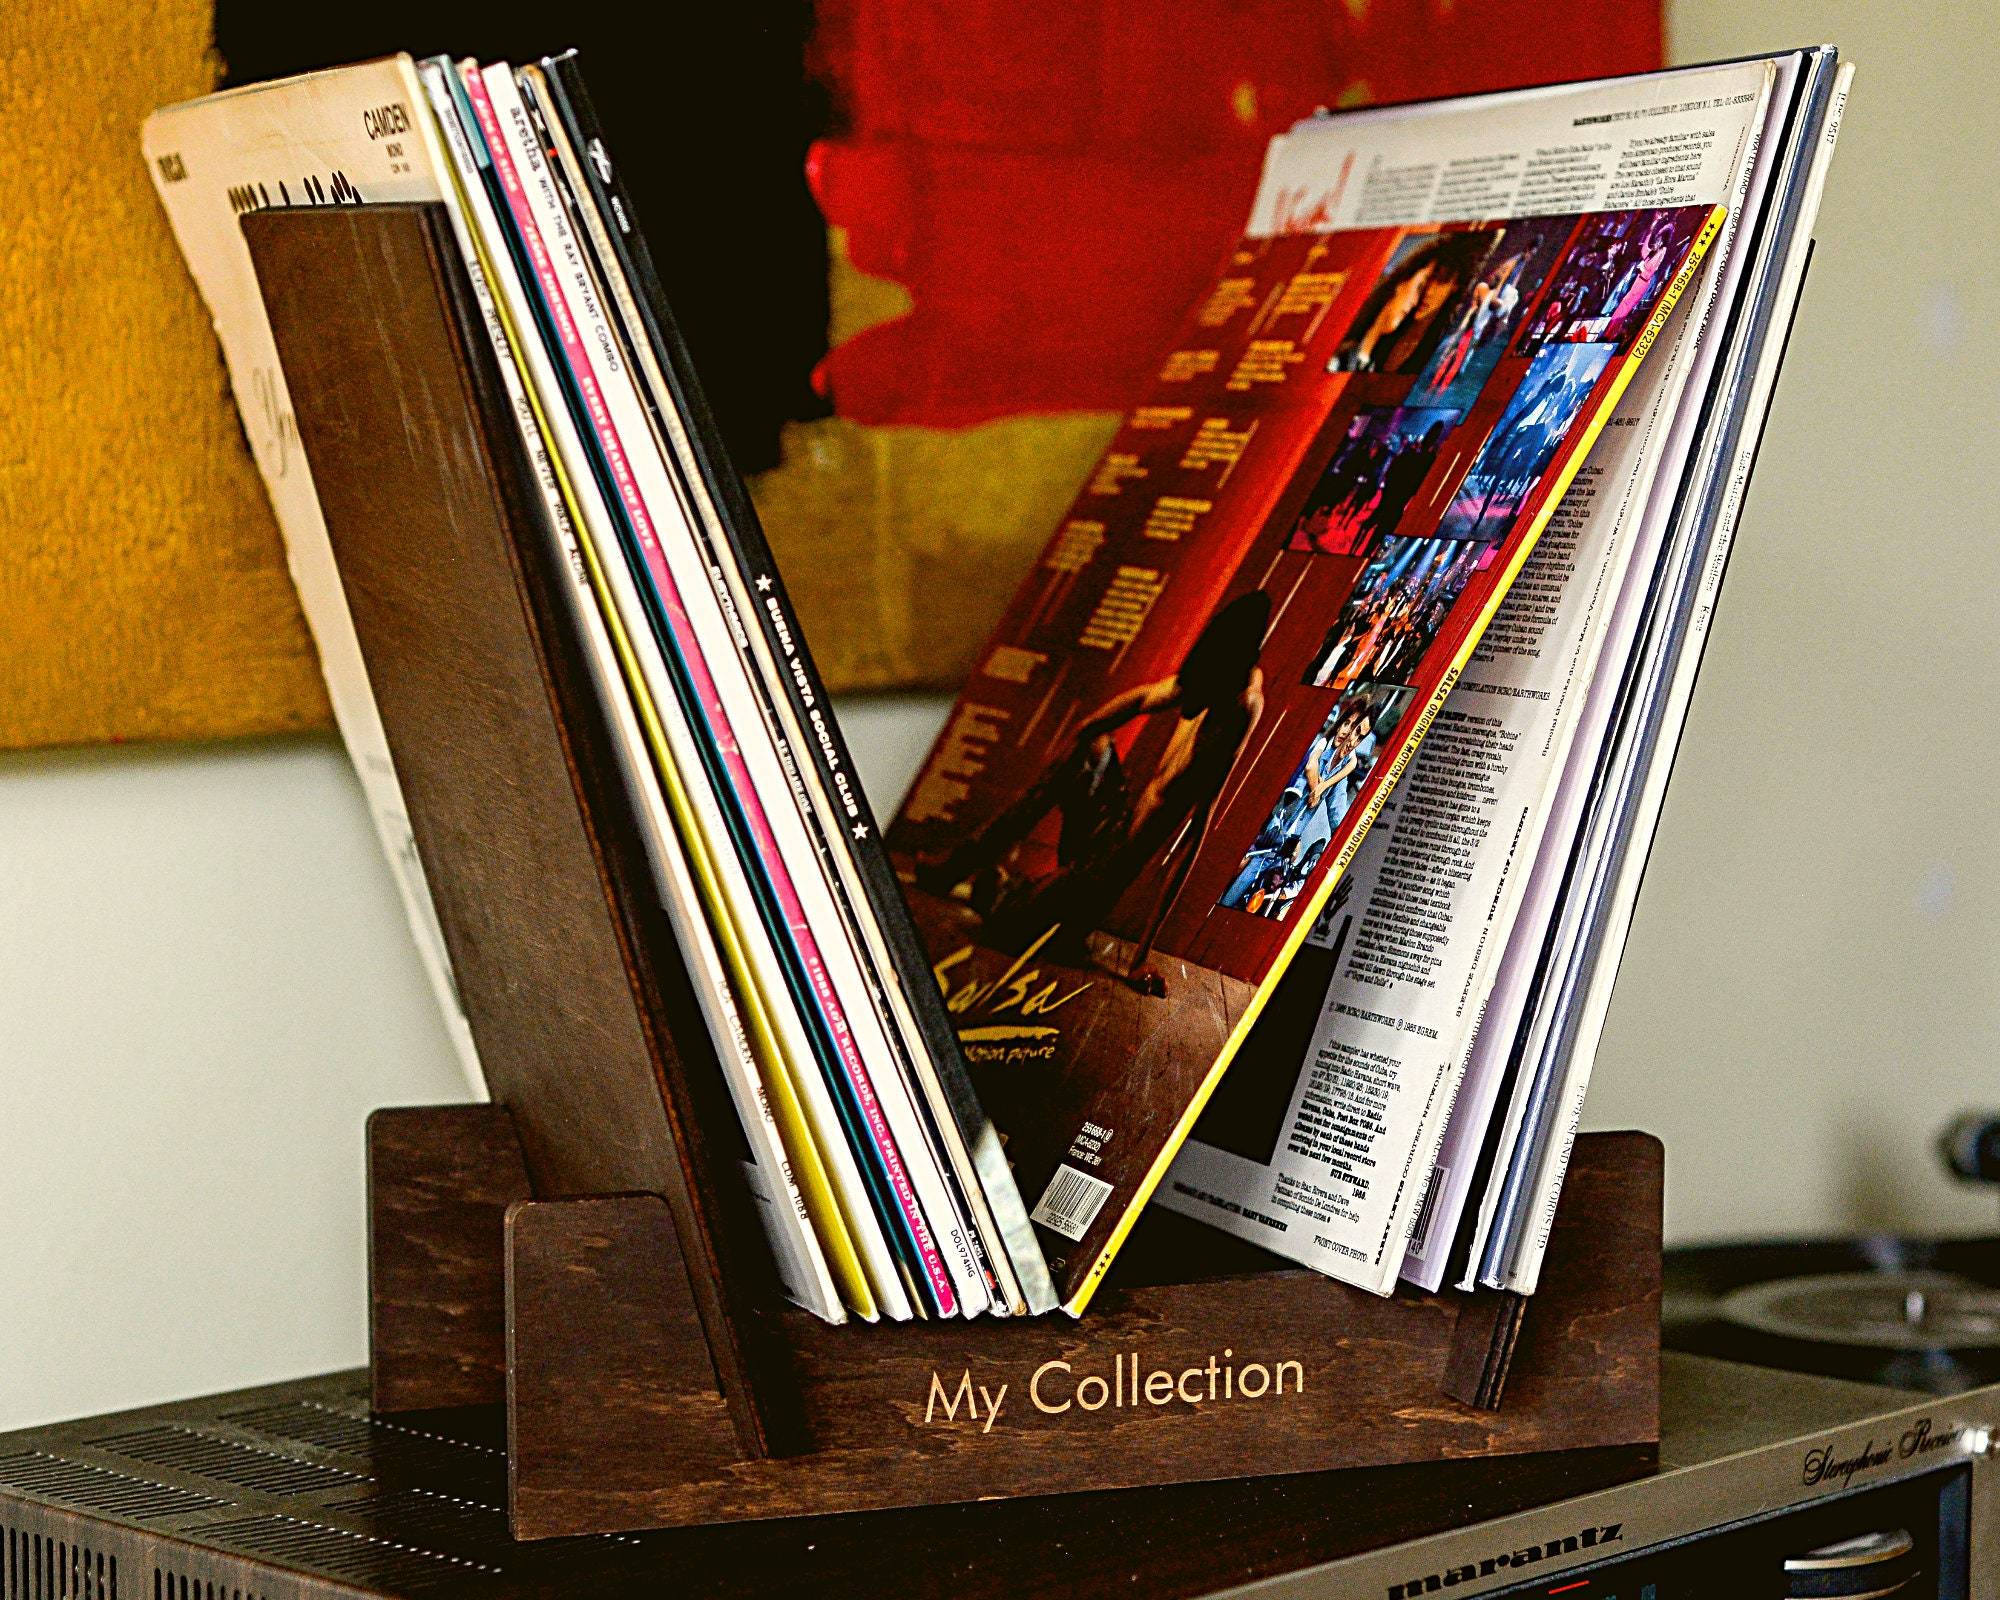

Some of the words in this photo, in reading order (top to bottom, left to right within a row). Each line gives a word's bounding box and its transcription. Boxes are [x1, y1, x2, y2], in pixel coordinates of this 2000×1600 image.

[363, 103, 411, 140] CAMDEN
[1825, 120, 1838, 144] 9517
[1738, 167, 1751, 195] RITMO
[1747, 155, 1755, 165] EL
[509, 104, 545, 172] aretha
[537, 175, 557, 210] WITH
[551, 214, 567, 237] THE
[563, 242, 578, 266] RAY
[572, 270, 599, 320] BRYANT
[594, 323, 619, 372] COMBO
[1729, 205, 1741, 228] CUBA
[1713, 259, 1726, 291] CUBAN
[1630, 298, 1673, 360] (MCA-6232)
[1702, 292, 1717, 322] DANCE
[1693, 323, 1706, 350] MUSIC
[540, 270, 576, 344] JOHNSON
[581, 375, 607, 426] EVERY
[601, 428, 629, 482] SHADE
[622, 483, 637, 505] OF
[632, 508, 654, 549] LOVE
[1555, 677, 1571, 715] thanks
[1567, 656, 1578, 676] due
[1574, 644, 1581, 655] to
[1578, 614, 1591, 642] Mary
[1605, 537, 1615, 556] Ian
[1624, 478, 1634, 497] and
[1433, 666, 1460, 702] SALSA
[1511, 686, 1551, 701] EARTHWORKS
[764, 596, 796, 656] BUENA
[788, 656, 816, 707] VISTA
[807, 708, 840, 771] SOCIAL
[833, 770, 859, 818] CLUB
[1409, 702, 1439, 743] ORIGINAL
[1388, 742, 1415, 779] MOTION
[1455, 971, 1474, 1017] SLEEVE
[1470, 926, 1489, 970] DESIGN
[1486, 876, 1505, 921] BUNCH
[1501, 858, 1511, 875] OF
[1508, 805, 1528, 858] ARTISTS
[932, 923, 1094, 1016] Salsa
[1359, 1008, 1395, 1028] EARTHWORKS
[1460, 998, 1488, 1069] EARTHWORKS
[838, 1035, 875, 1105] RECORDS,
[868, 1107, 886, 1136] INC.
[880, 1138, 913, 1201] PRINTED
[905, 1202, 919, 1220] IN
[914, 1224, 932, 1252] THE
[926, 1254, 948, 1293] U.S.A.
[780, 1160, 797, 1187] CDM
[791, 1192, 808, 1220] 1088
[1373, 1221, 1391, 1265] BARRY
[1388, 1179, 1405, 1220] LEWIS
[1402, 1120, 1424, 1178] COURTESY
[950, 1228, 975, 1278] DOL974HG
[1312, 1234, 1333, 1249] FRONT
[1330, 1241, 1350, 1255] COVER
[1347, 1248, 1370, 1263] PHOTO:
[925, 1368, 1008, 1434] My
[1030, 1349, 1303, 1414] Collection
[1387, 1523, 1623, 1600] marantz
